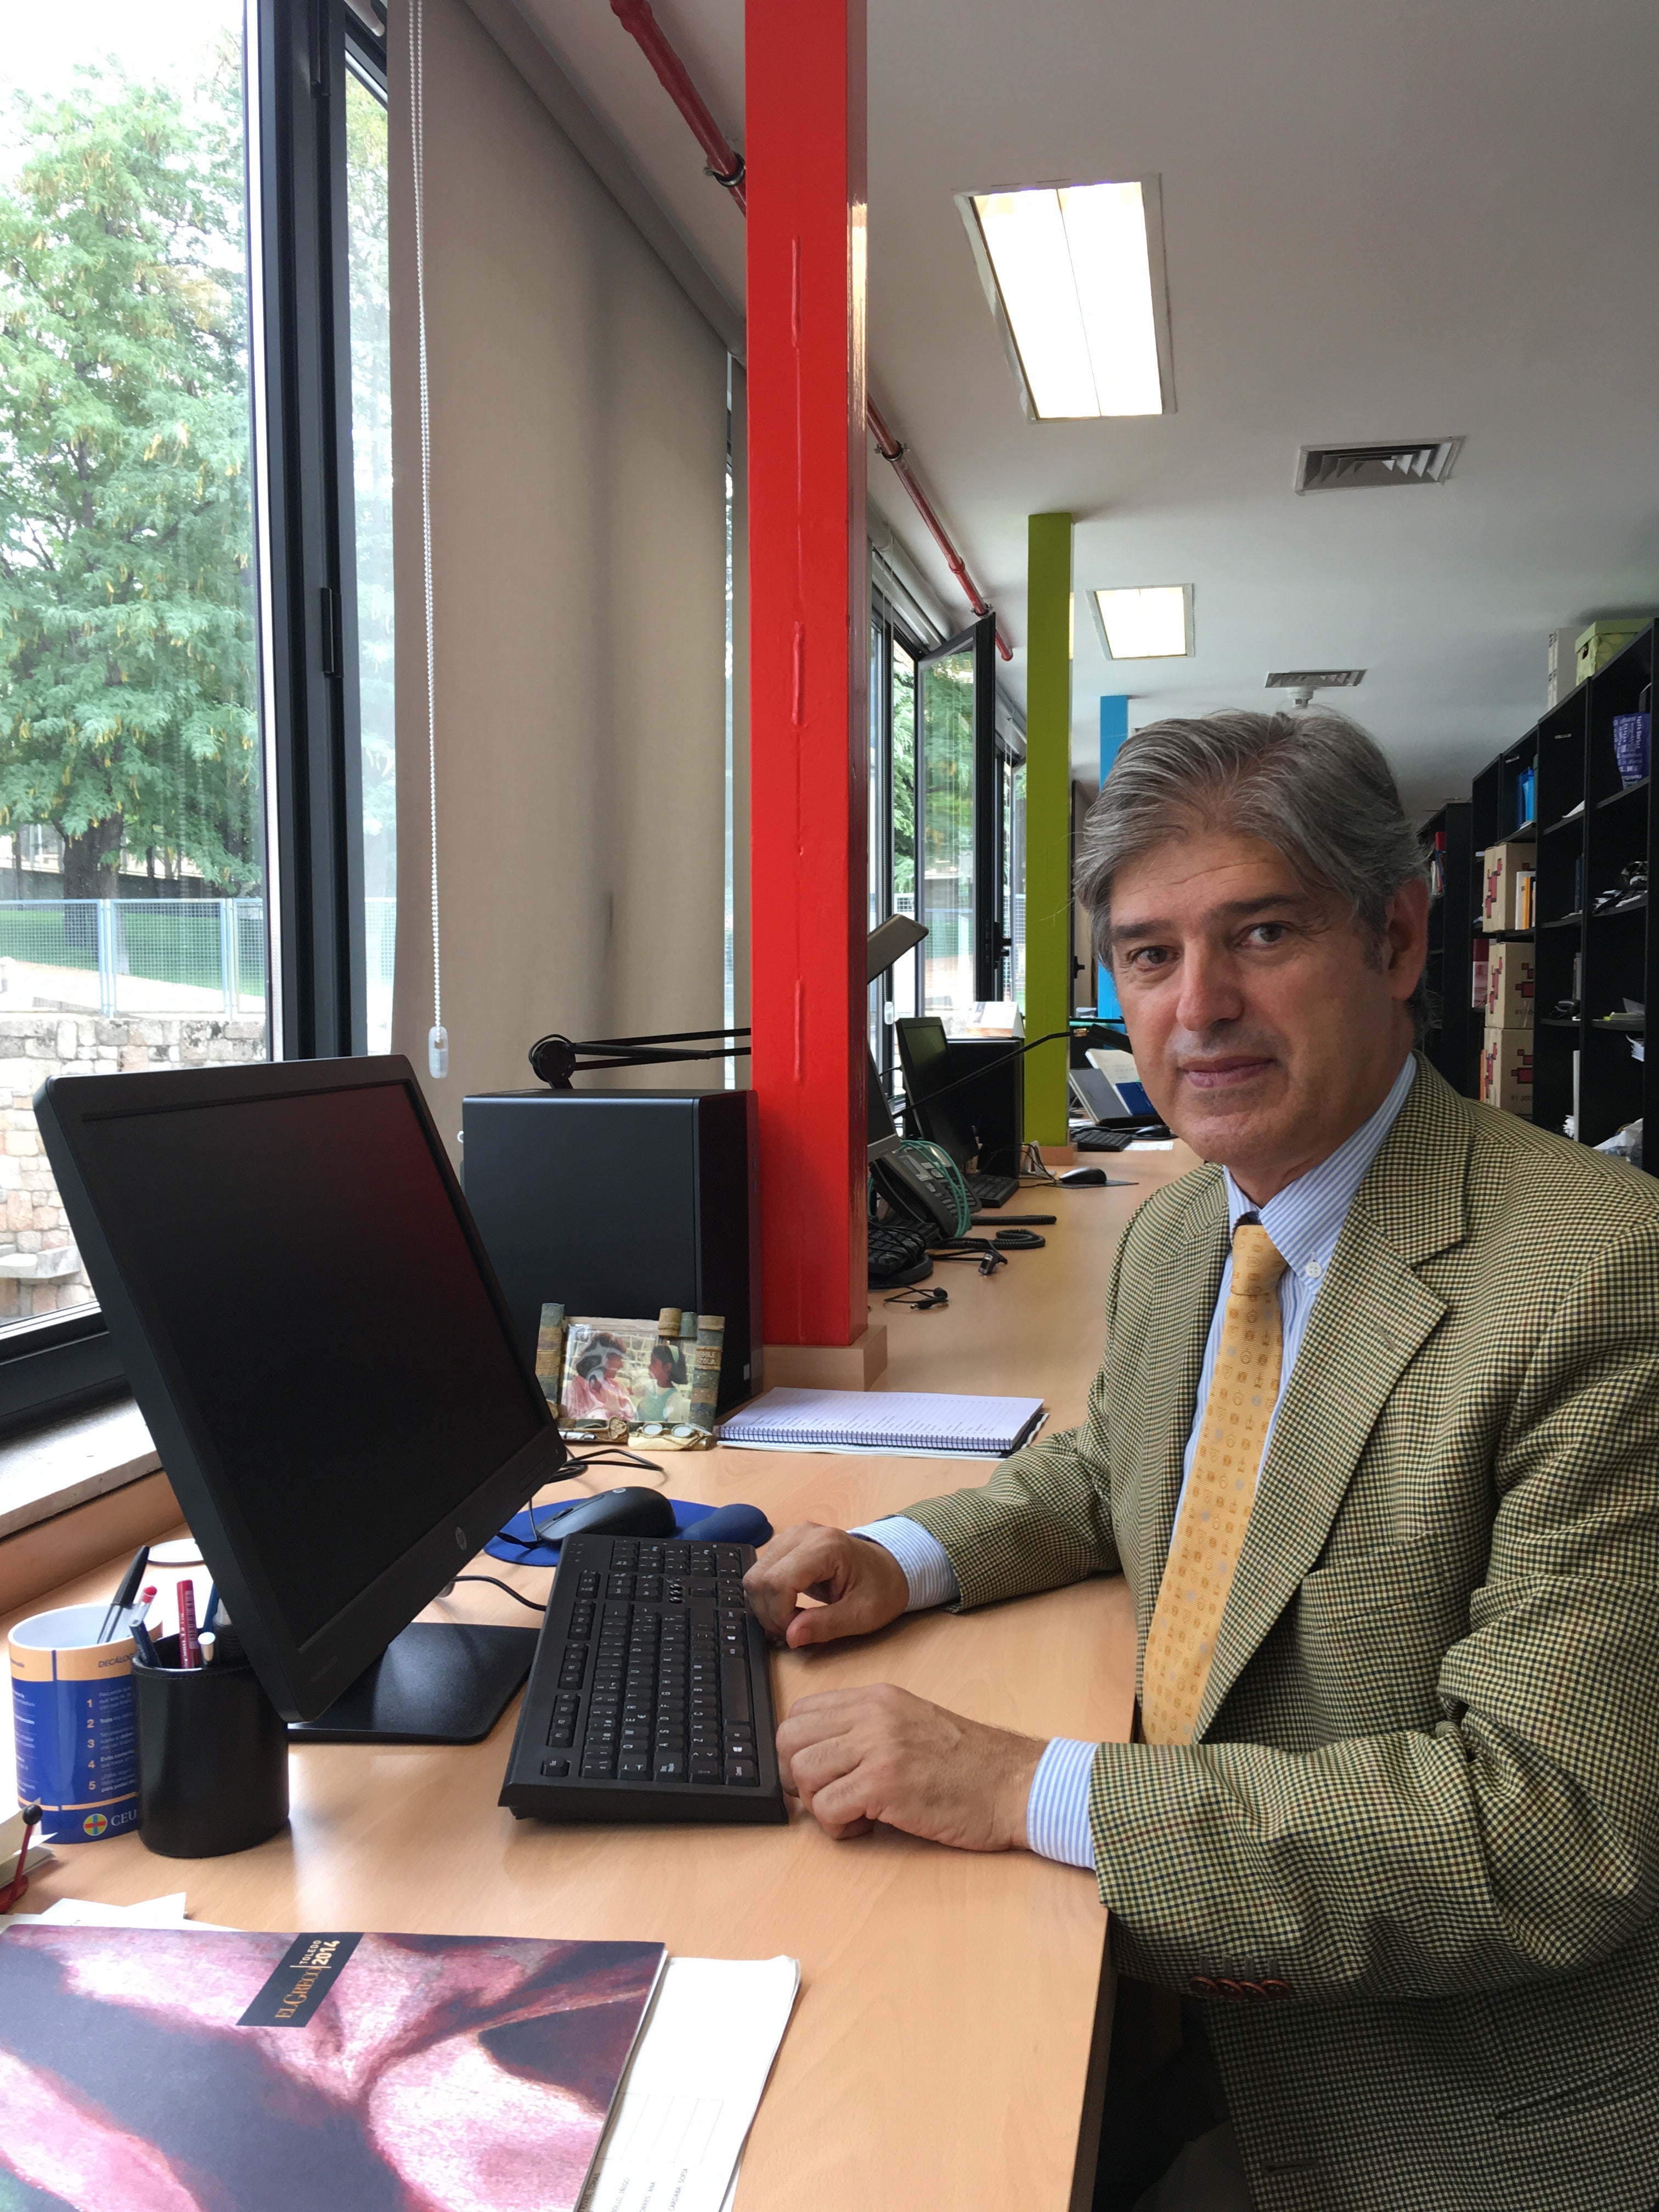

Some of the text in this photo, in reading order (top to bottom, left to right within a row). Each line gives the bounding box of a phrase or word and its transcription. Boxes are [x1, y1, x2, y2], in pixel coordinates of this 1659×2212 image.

[86, 1699, 92, 1708] 1
[87, 1719, 94, 1728] 2
[87, 1739, 95, 1748] 3
[88, 1760, 95, 1769] 4
[88, 1781, 96, 1790] 5
[111, 1809, 137, 1826] CEU
[298, 1940, 321, 1965] TOLEDO
[311, 1940, 340, 1965] 2014
